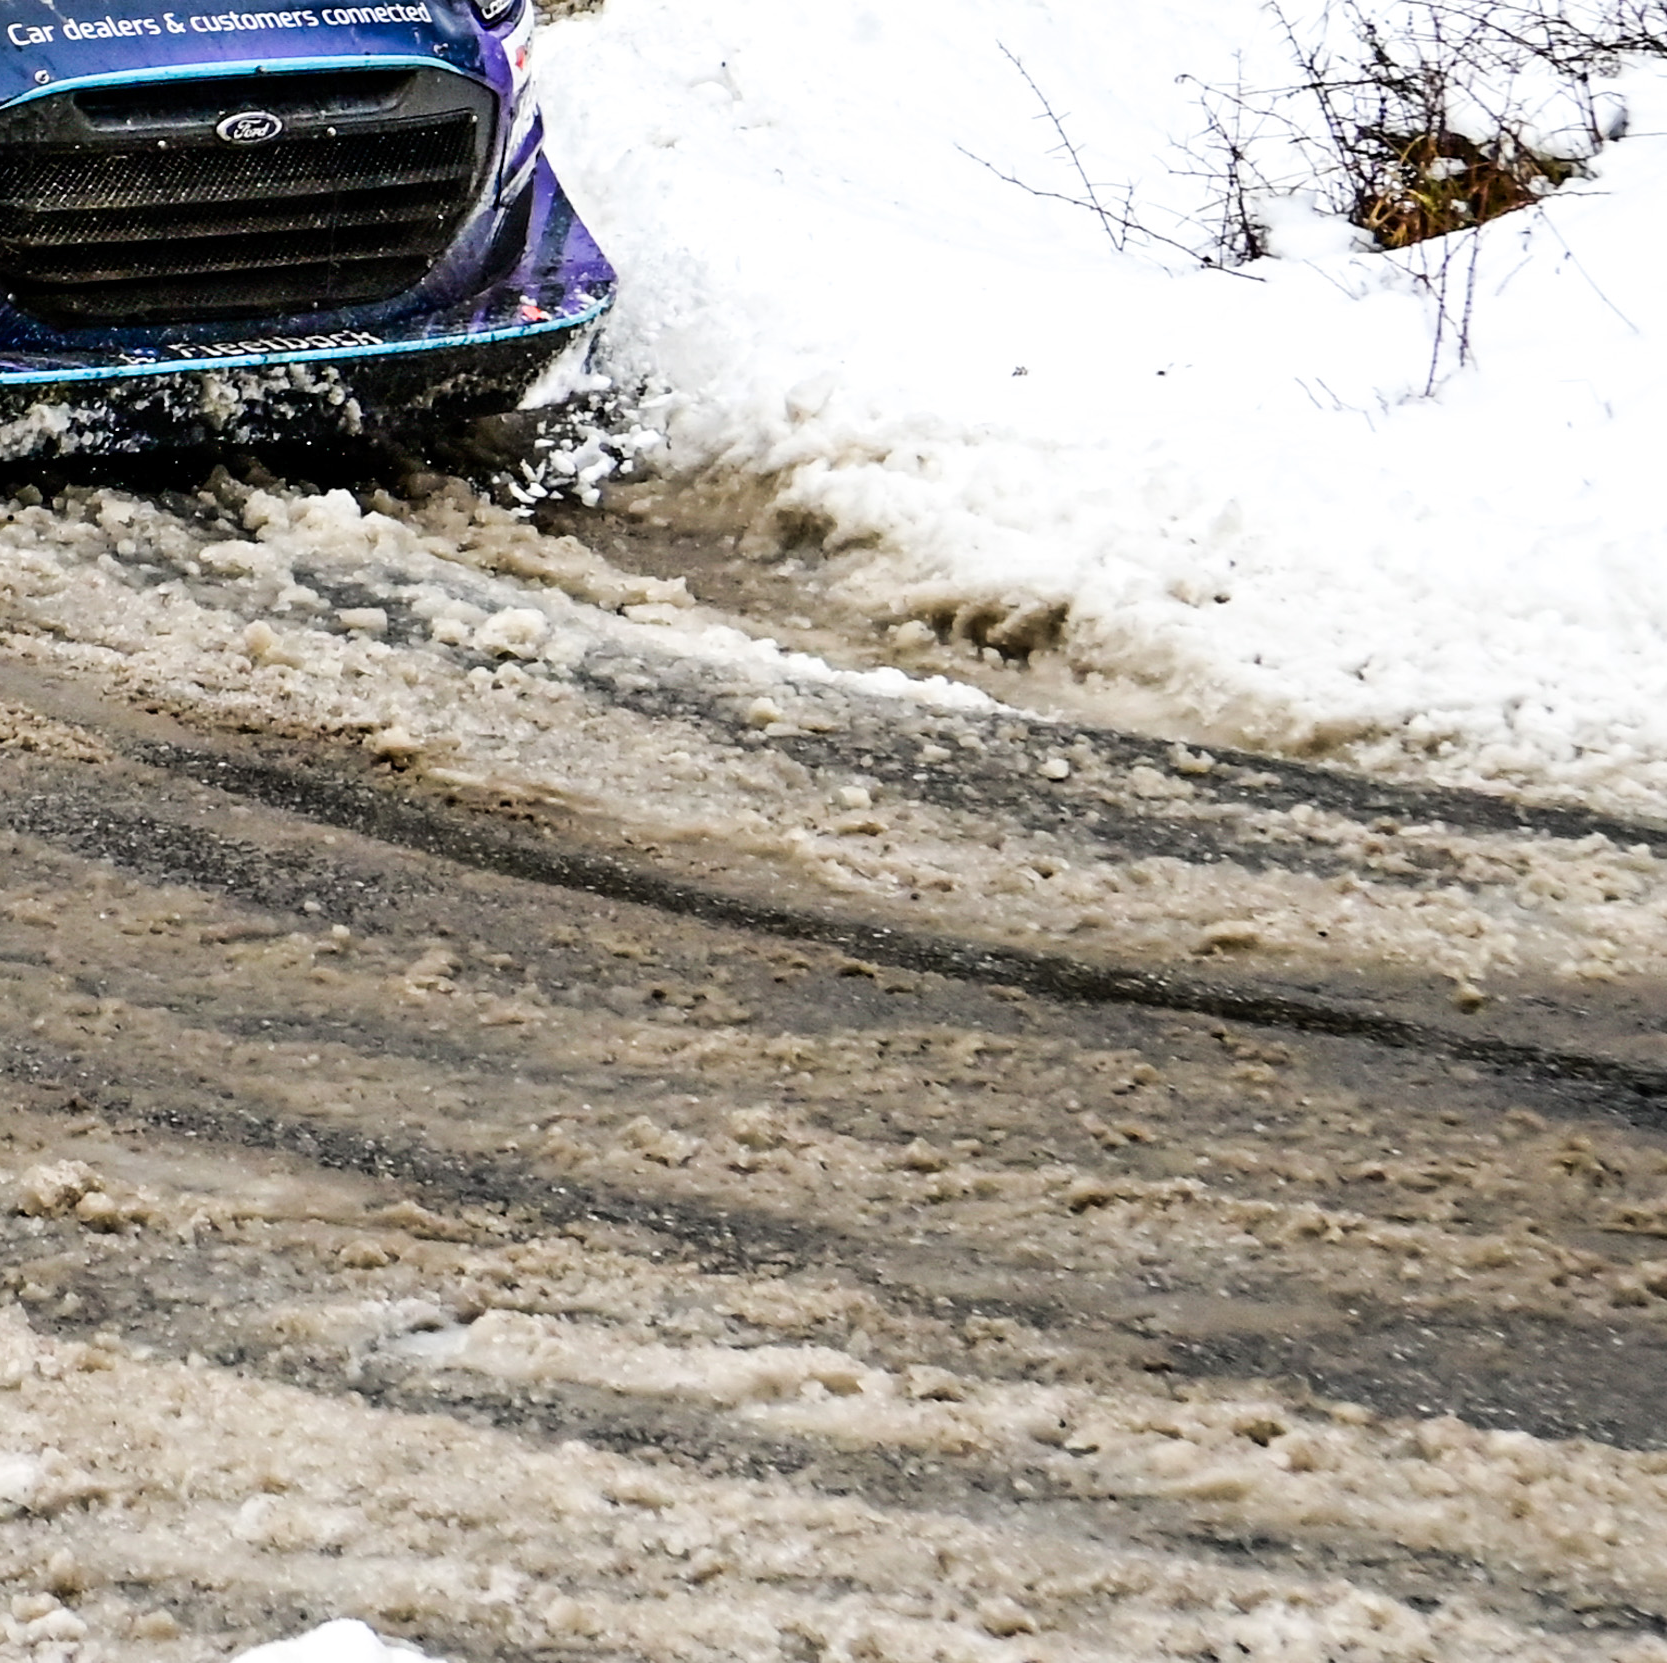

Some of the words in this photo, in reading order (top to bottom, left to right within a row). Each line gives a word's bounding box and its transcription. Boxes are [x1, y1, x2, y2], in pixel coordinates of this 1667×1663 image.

[7, 22, 55, 47] Car
[62, 14, 162, 42] dealers
[162, 11, 186, 35] &
[189, 6, 320, 33] customers
[321, 1, 434, 27] connected
[233, 119, 271, 140] Ford
